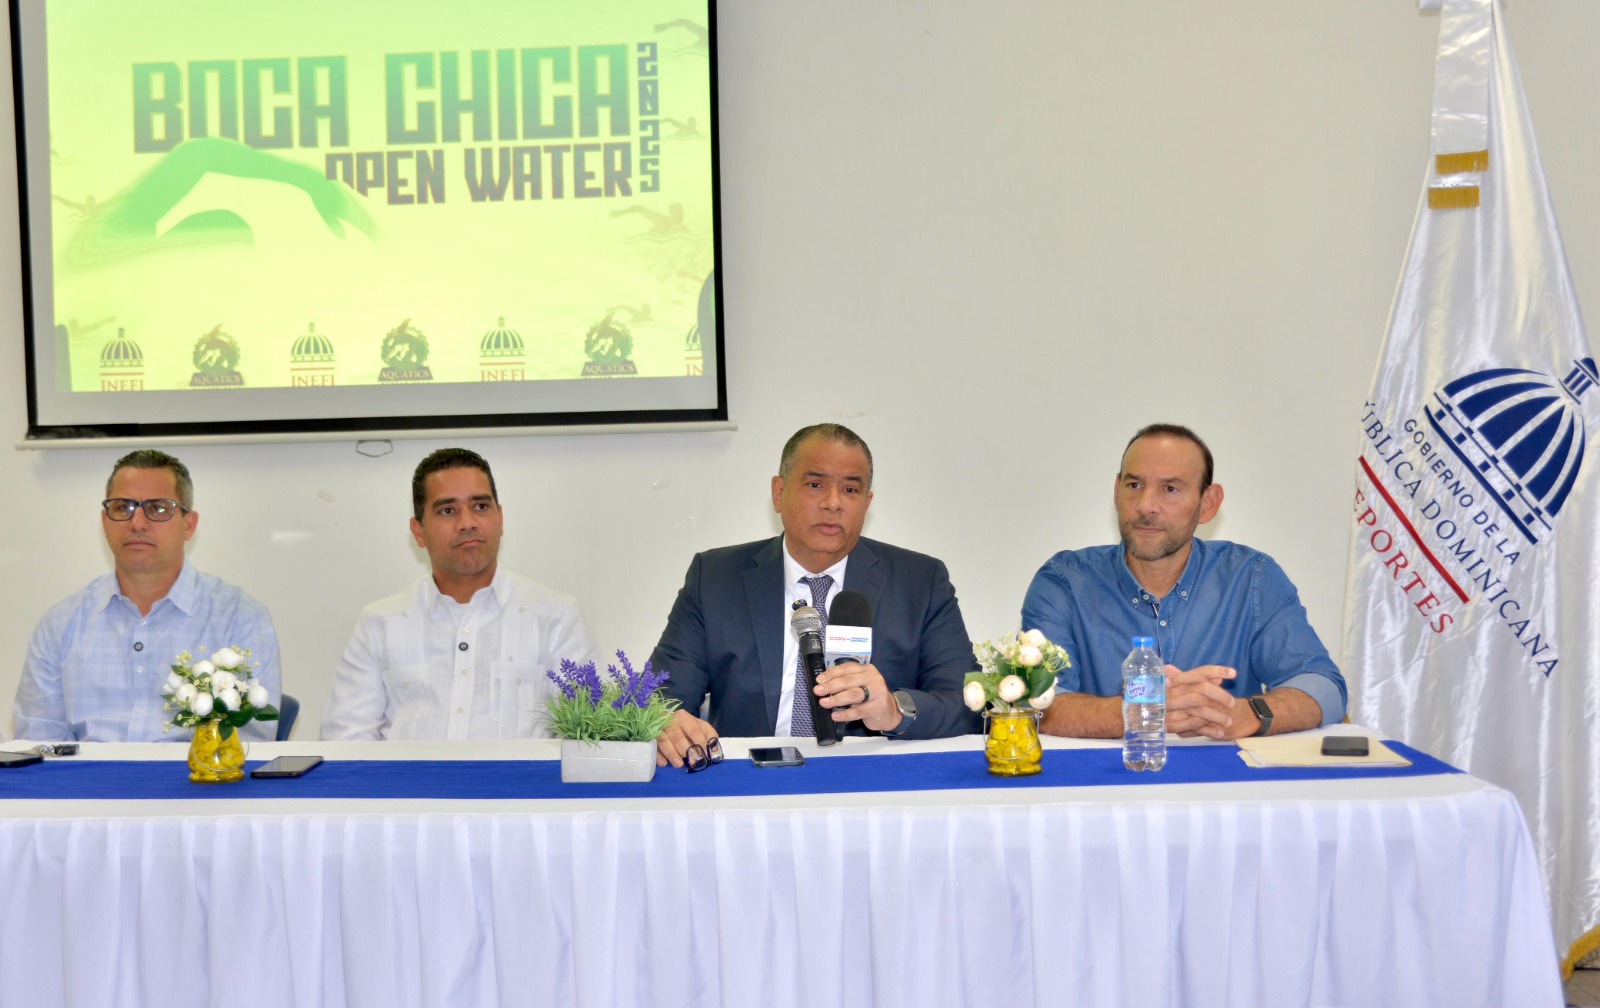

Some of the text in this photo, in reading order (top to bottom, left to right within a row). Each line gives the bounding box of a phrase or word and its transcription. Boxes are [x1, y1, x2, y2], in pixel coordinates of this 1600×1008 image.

[132, 44, 631, 154] BOCA CHICA
[637, 42, 660, 193] 2025
[325, 142, 633, 206] OPEN WATER
[193, 375, 241, 384] AQUATICS
[381, 370, 430, 380] AQUATICS
[584, 363, 634, 374] AQUATICS
[1404, 418, 1521, 565] GOBIERNO DE LA
[1420, 498, 1559, 678] DOMINICANA
